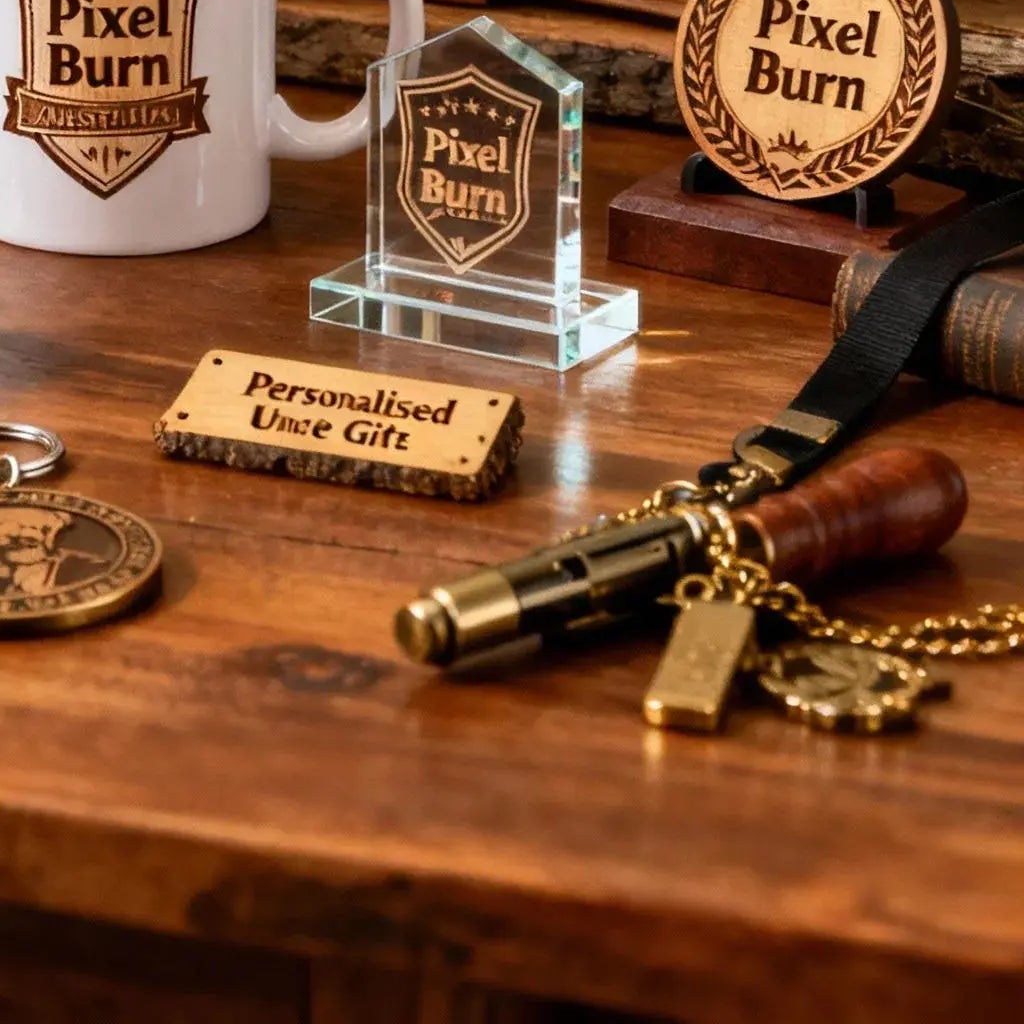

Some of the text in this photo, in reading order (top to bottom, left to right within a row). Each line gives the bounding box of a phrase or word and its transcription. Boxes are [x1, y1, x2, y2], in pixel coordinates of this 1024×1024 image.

[47, 42, 171, 88] Burn
[744, 46, 866, 112] Burn
[422, 126, 511, 174] Pixel
[420, 167, 508, 216] Burn
[241, 371, 459, 425] Personalised
